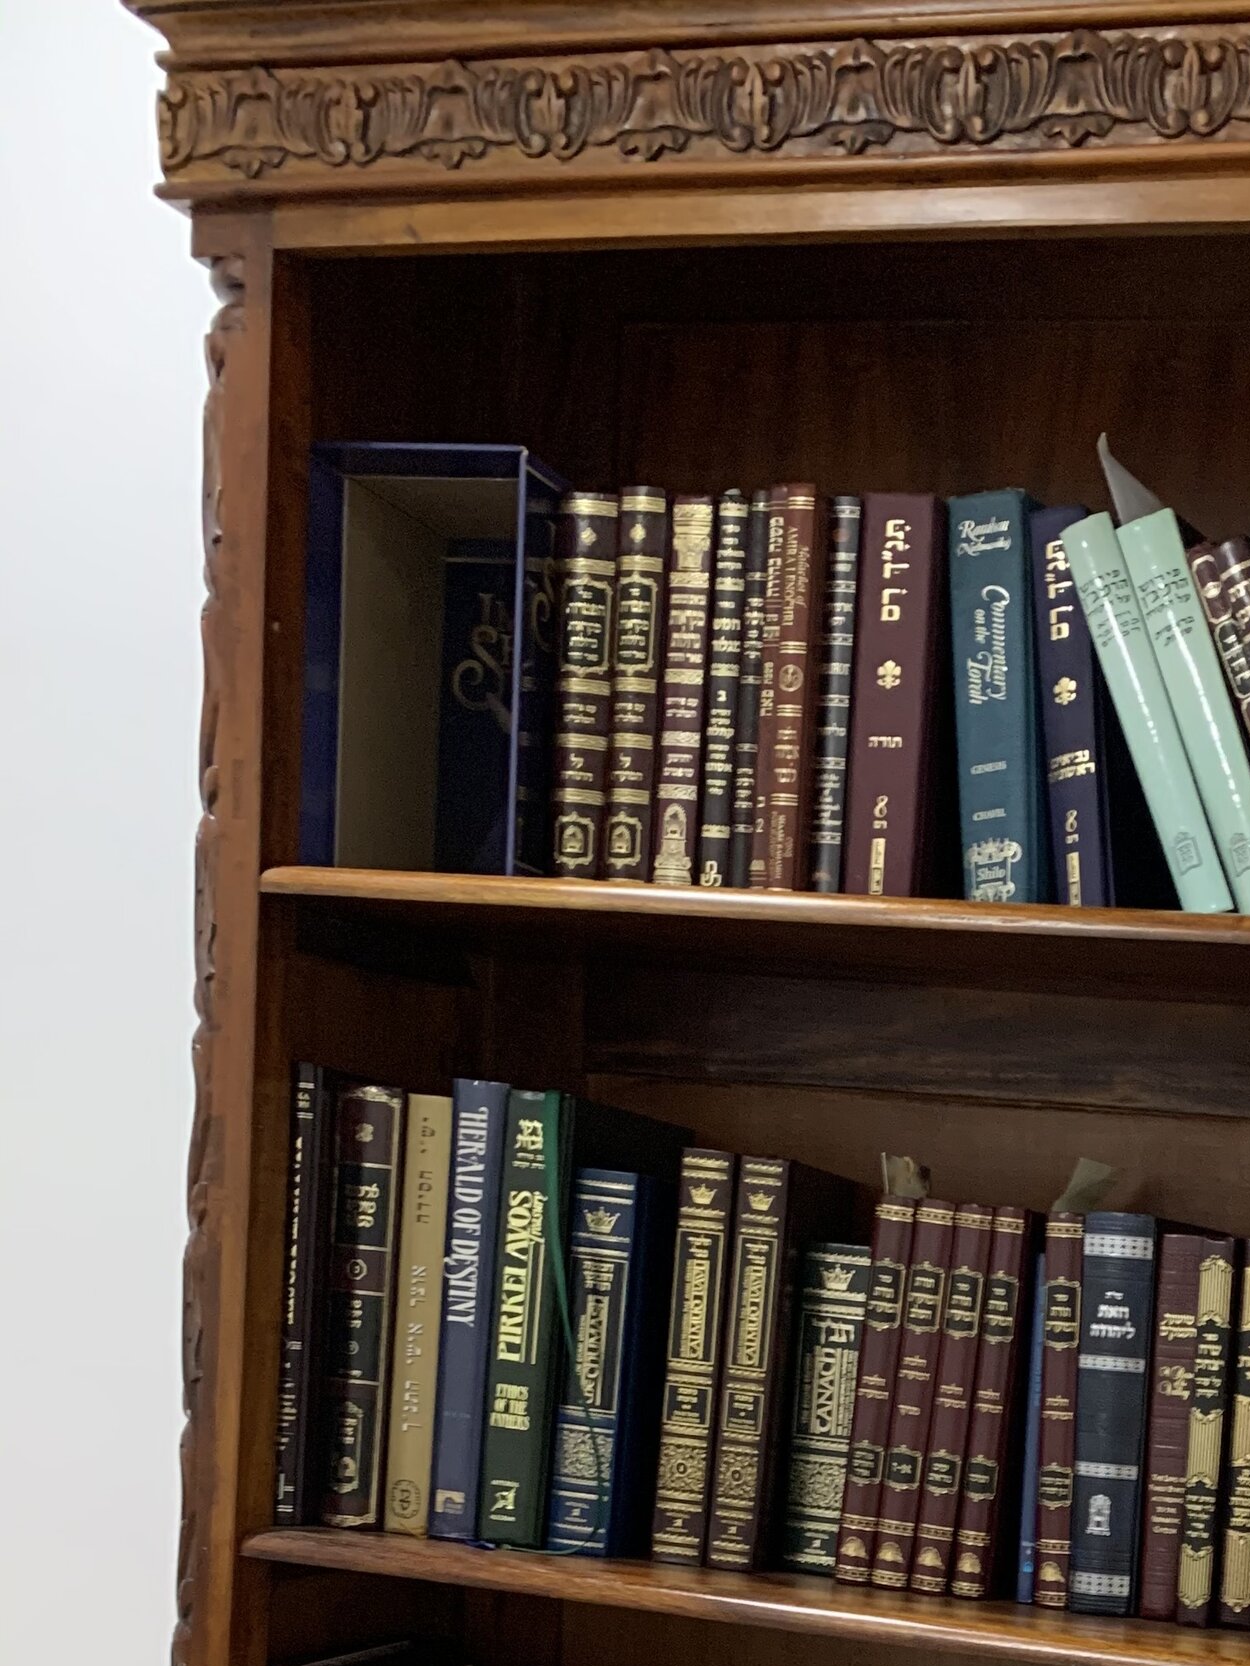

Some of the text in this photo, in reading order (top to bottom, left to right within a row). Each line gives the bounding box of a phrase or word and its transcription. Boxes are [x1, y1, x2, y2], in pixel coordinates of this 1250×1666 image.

[974, 609, 989, 644] on the
[981, 584, 1011, 702] Commentary
[967, 651, 996, 705] Torah
[868, 735, 902, 749] תורה
[443, 1106, 489, 1328] HERALD OF DESTINY
[409, 1264, 428, 1308] אוצר
[496, 1190, 533, 1362] PIRKEI AVOS
